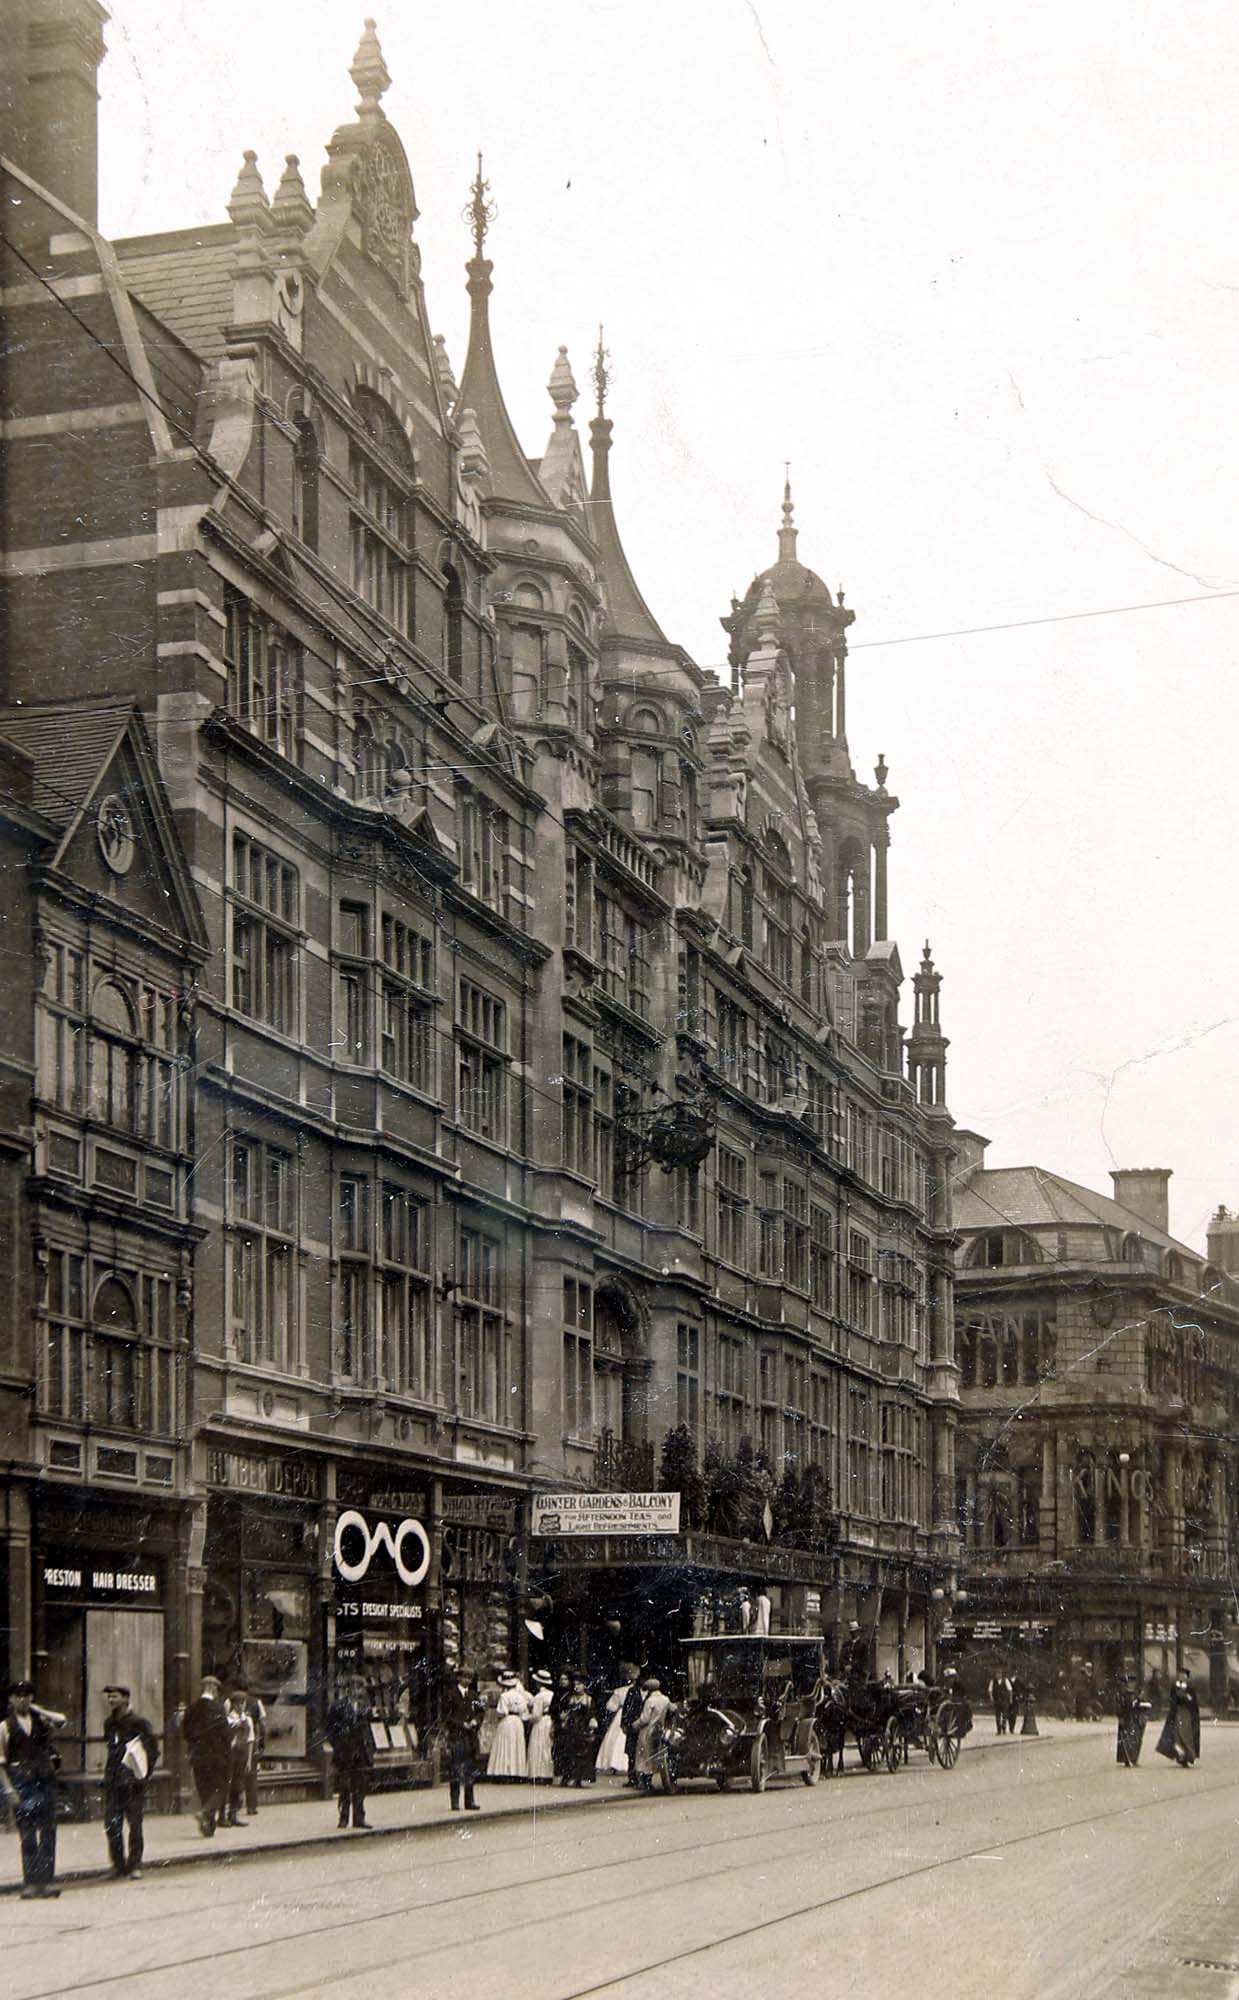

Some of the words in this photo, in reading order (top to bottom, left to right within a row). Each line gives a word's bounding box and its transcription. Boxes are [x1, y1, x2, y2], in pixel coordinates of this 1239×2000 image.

[207, 1450, 267, 1491] HUMBER
[536, 1496, 577, 1510] WINTER
[579, 1495, 622, 1509] GARDENS
[629, 1494, 675, 1508] BALCONY
[577, 1512, 626, 1521] AFTERNOON
[630, 1512, 652, 1520] TEAS
[92, 1572, 114, 1589] HAIR
[115, 1573, 156, 1591] DRESSER
[362, 1603, 388, 1616] EYESIGHT
[389, 1605, 422, 1618] SPECIALISTS
